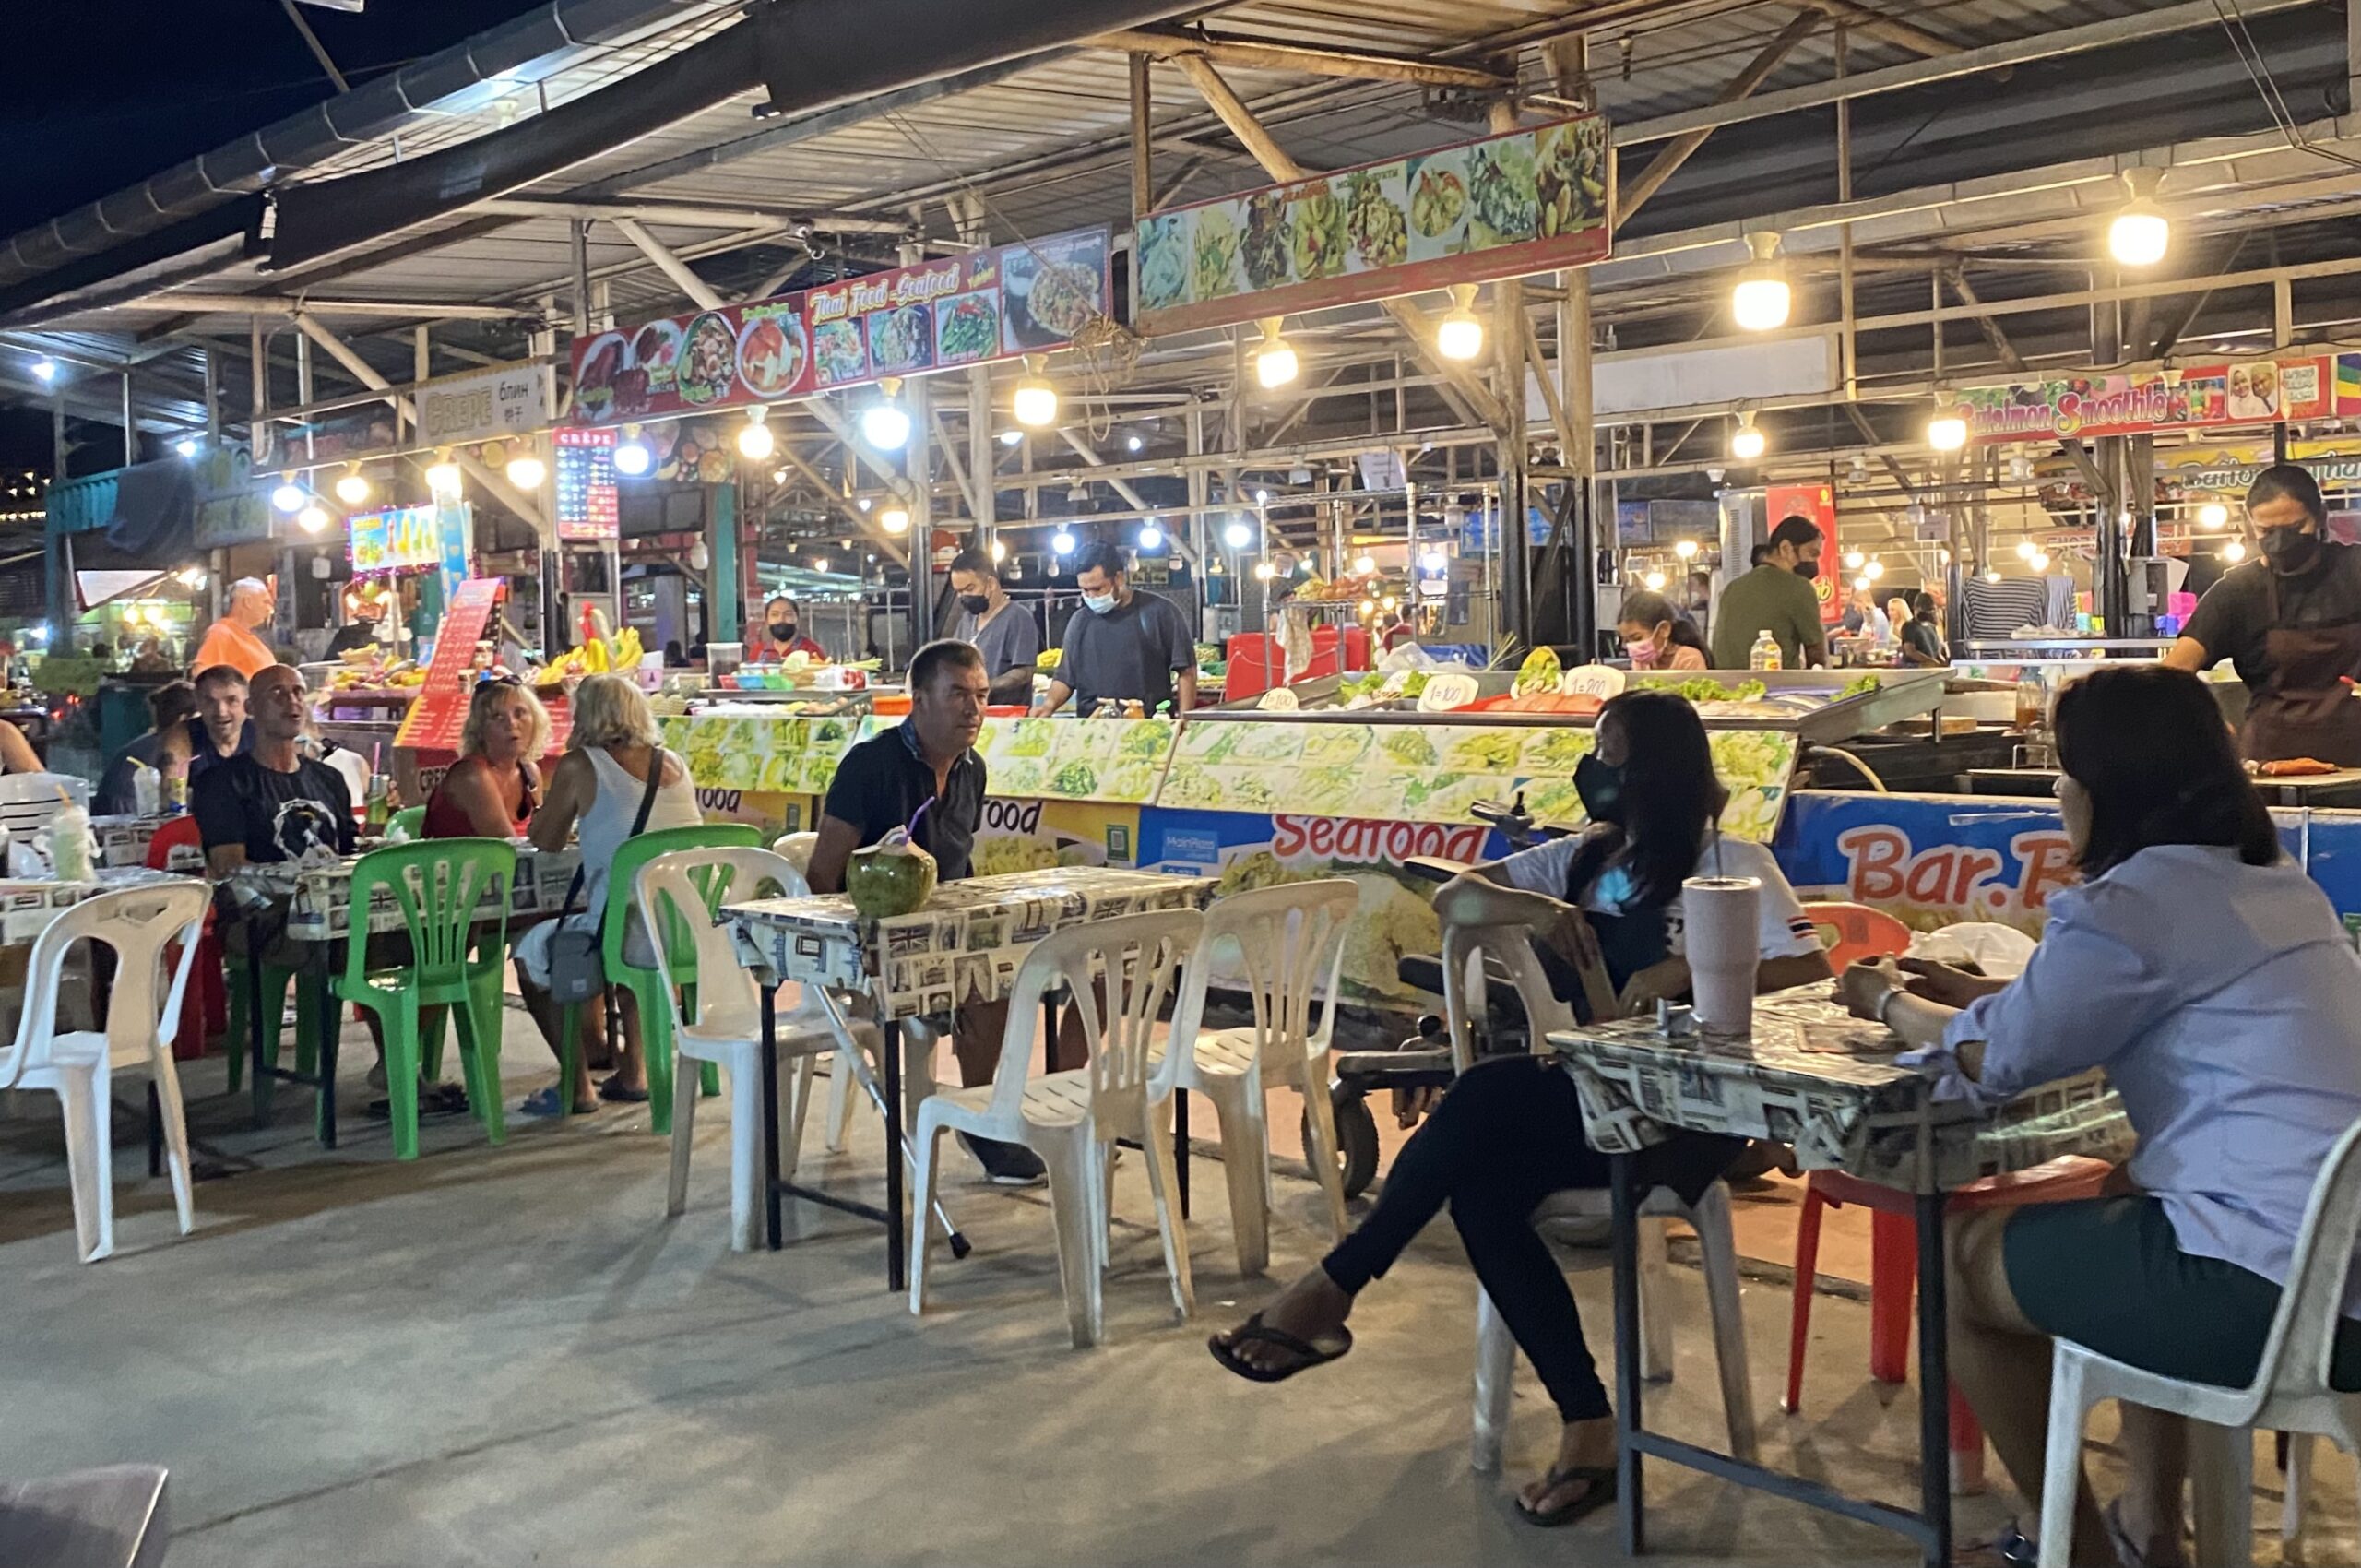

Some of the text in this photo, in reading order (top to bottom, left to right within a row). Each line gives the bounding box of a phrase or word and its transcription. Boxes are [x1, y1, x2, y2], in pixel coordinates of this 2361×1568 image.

[810, 289, 848, 323] Thai
[848, 279, 888, 317] Food
[499, 381, 528, 401] блин
[2053, 384, 2168, 437] Smoothie
